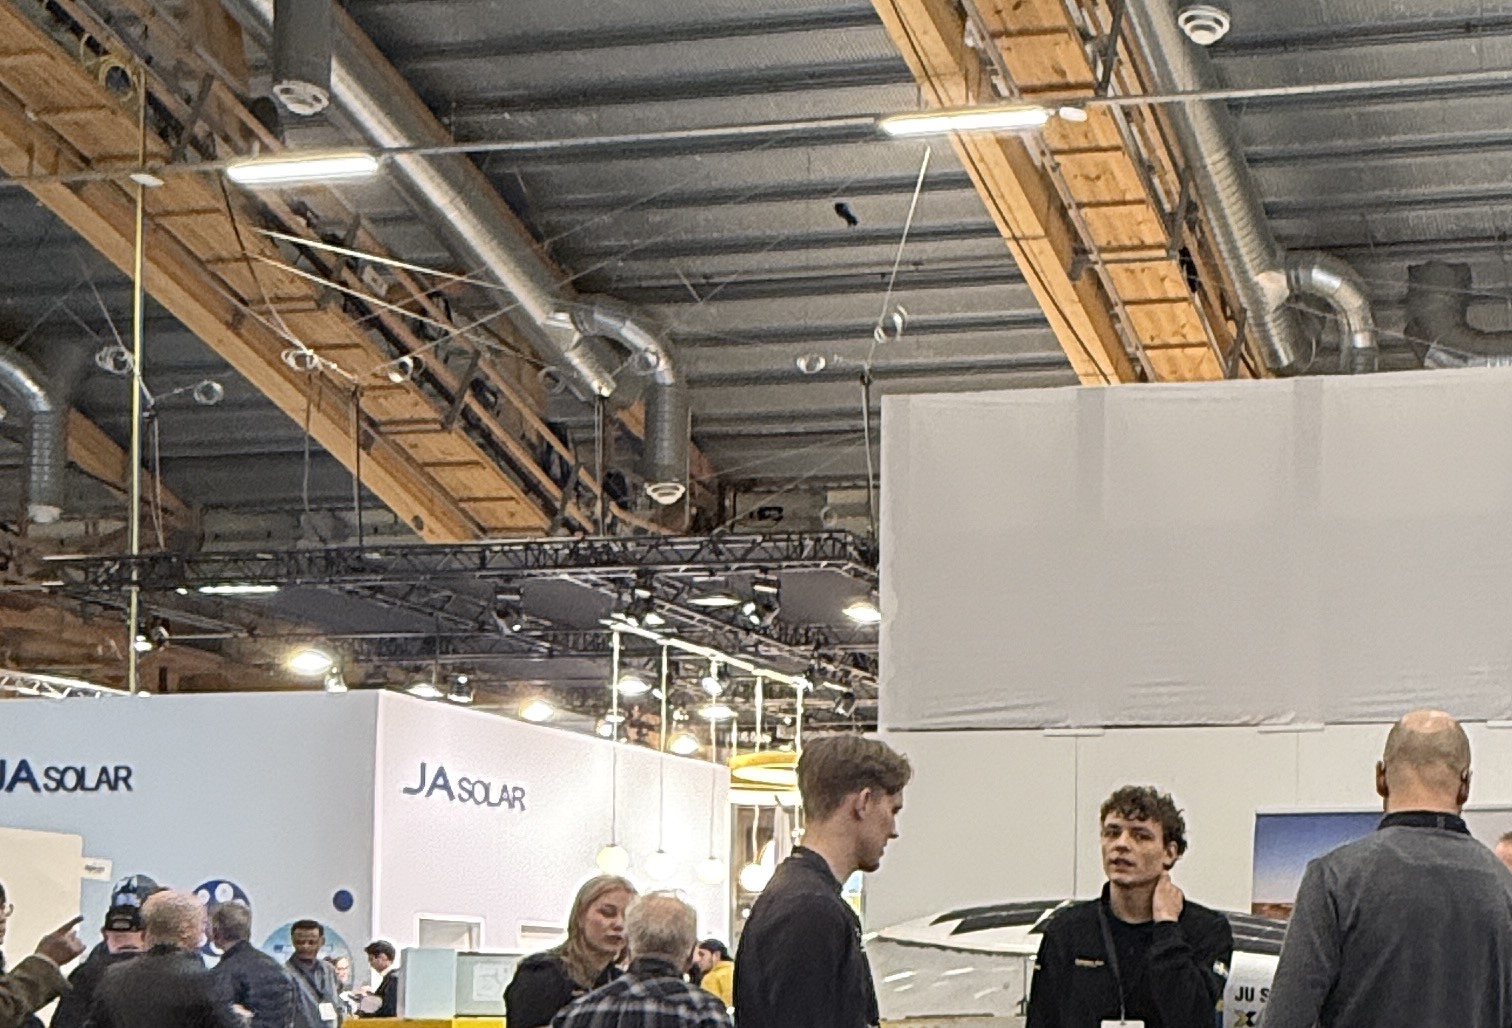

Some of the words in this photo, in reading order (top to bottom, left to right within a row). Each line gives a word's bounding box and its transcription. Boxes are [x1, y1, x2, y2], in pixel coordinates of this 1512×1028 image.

[43, 766, 133, 792] SOLAR
[402, 761, 456, 801] JA
[458, 776, 526, 812] SOLAR
[1235, 986, 1255, 1002] JU
